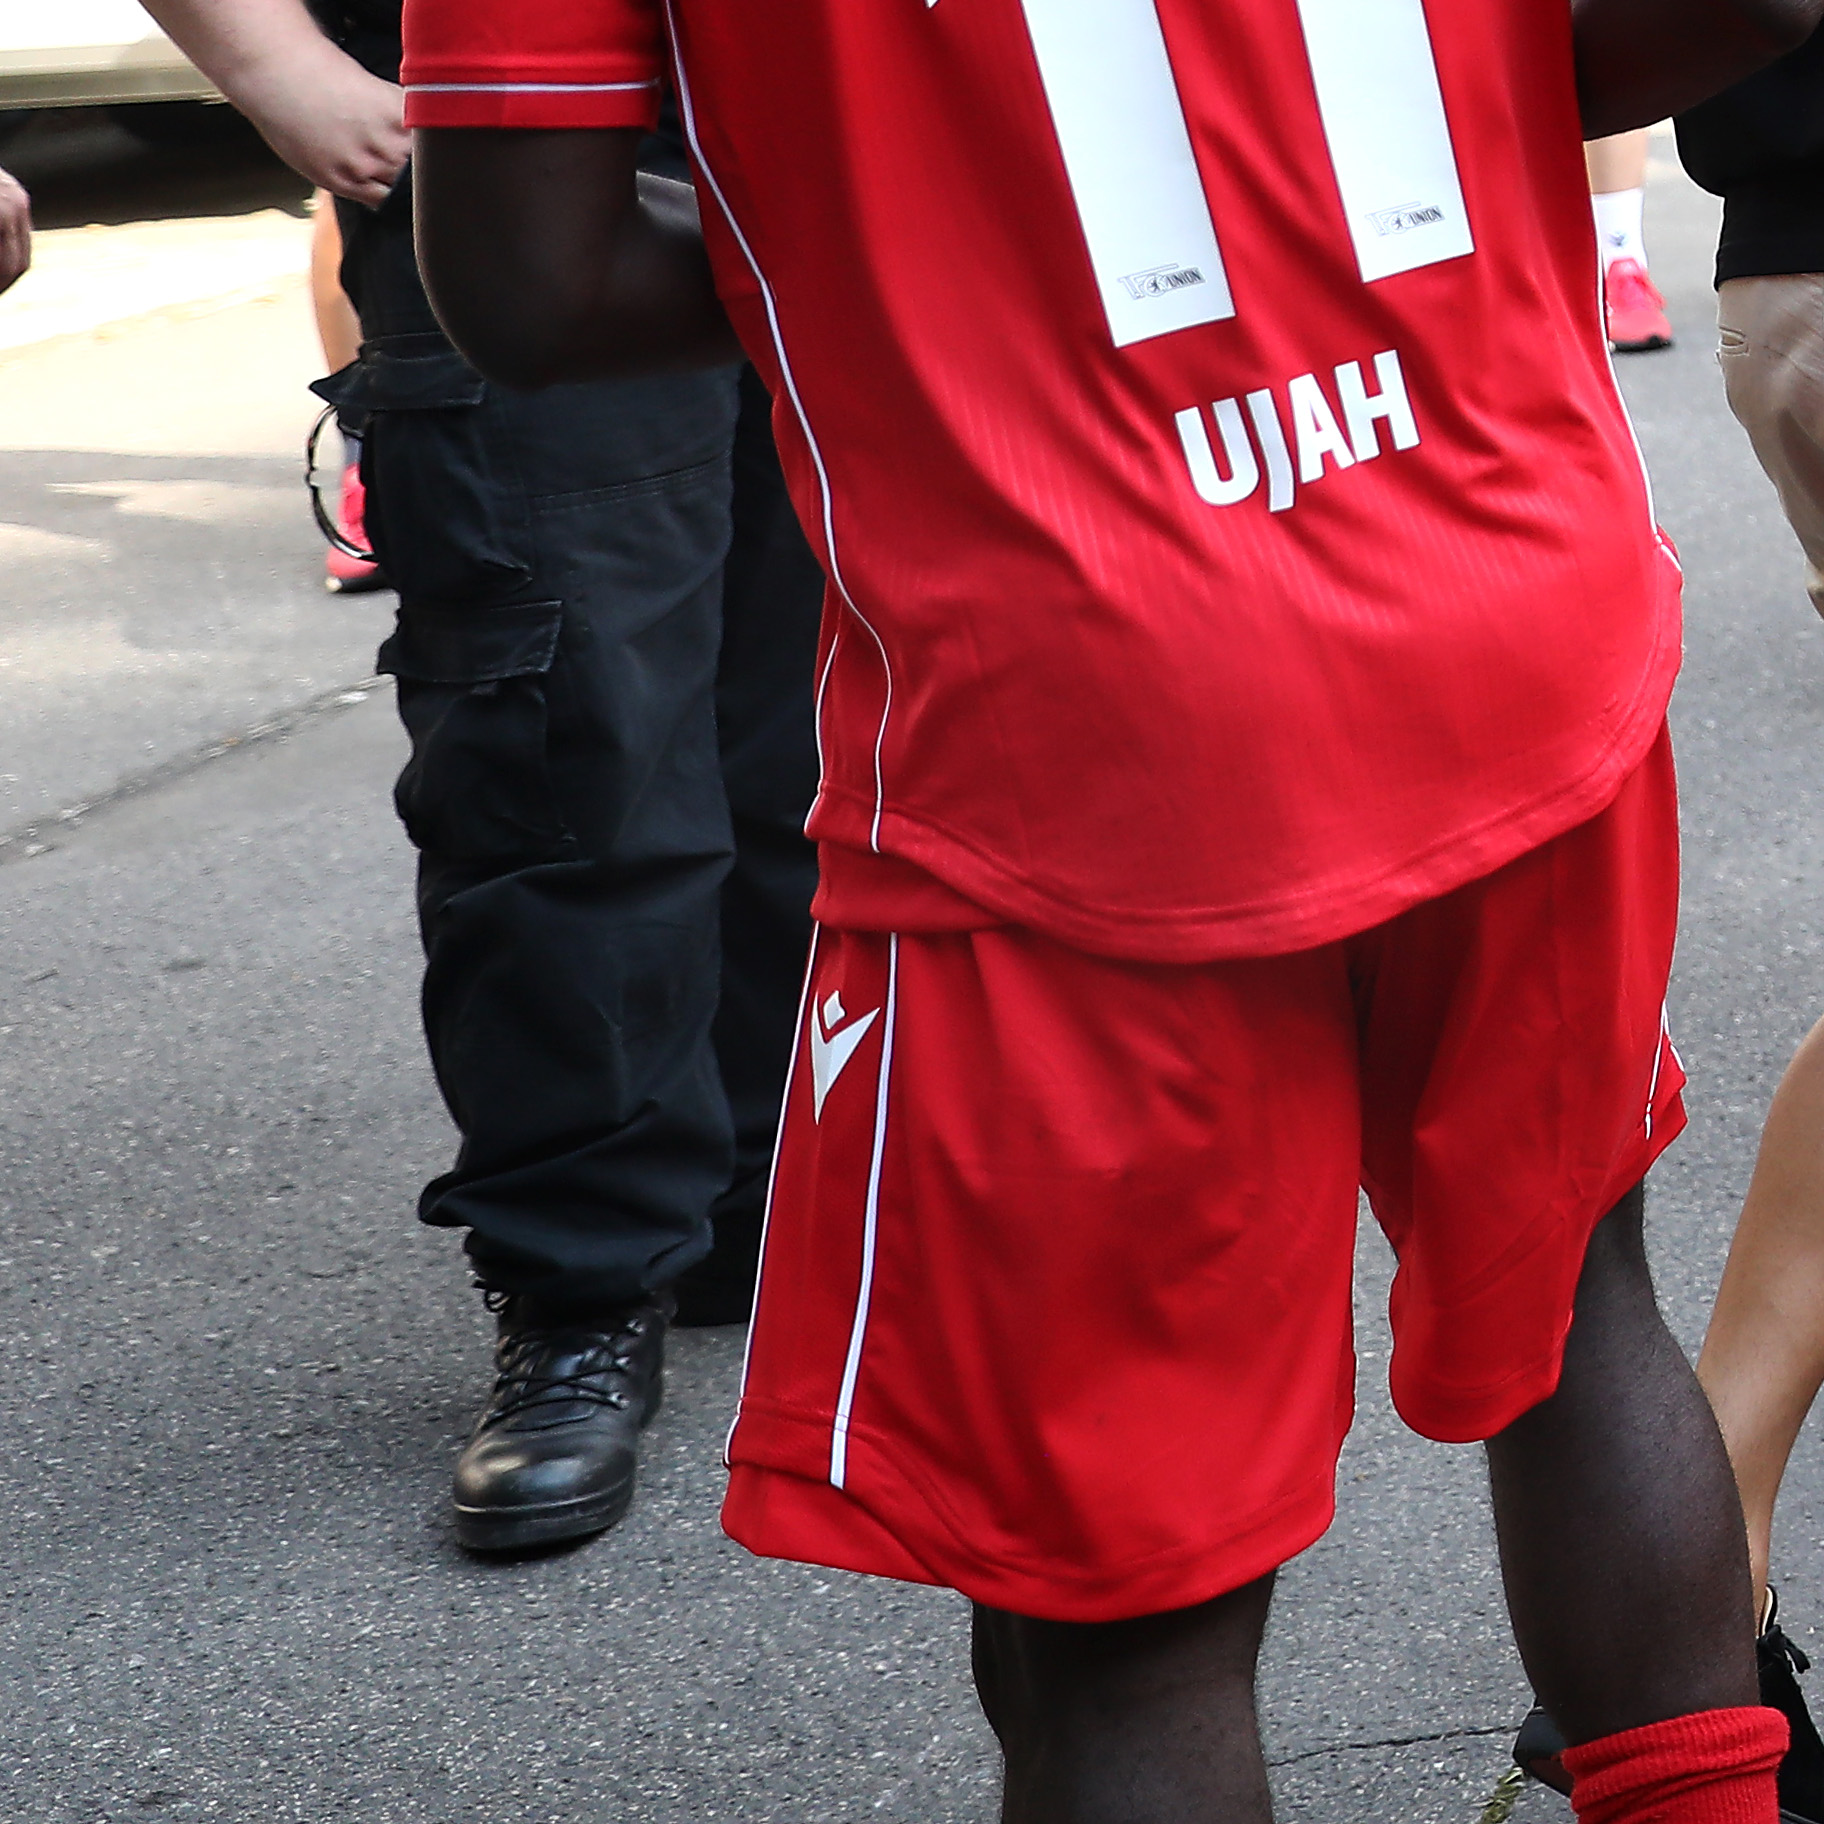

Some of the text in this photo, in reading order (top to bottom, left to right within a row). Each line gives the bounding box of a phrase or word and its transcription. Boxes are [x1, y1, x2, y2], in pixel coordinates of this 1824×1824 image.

[1409, 206, 1444, 226] UNION
[1167, 267, 1204, 290] UNION
[1174, 349, 1420, 512] UJAH
